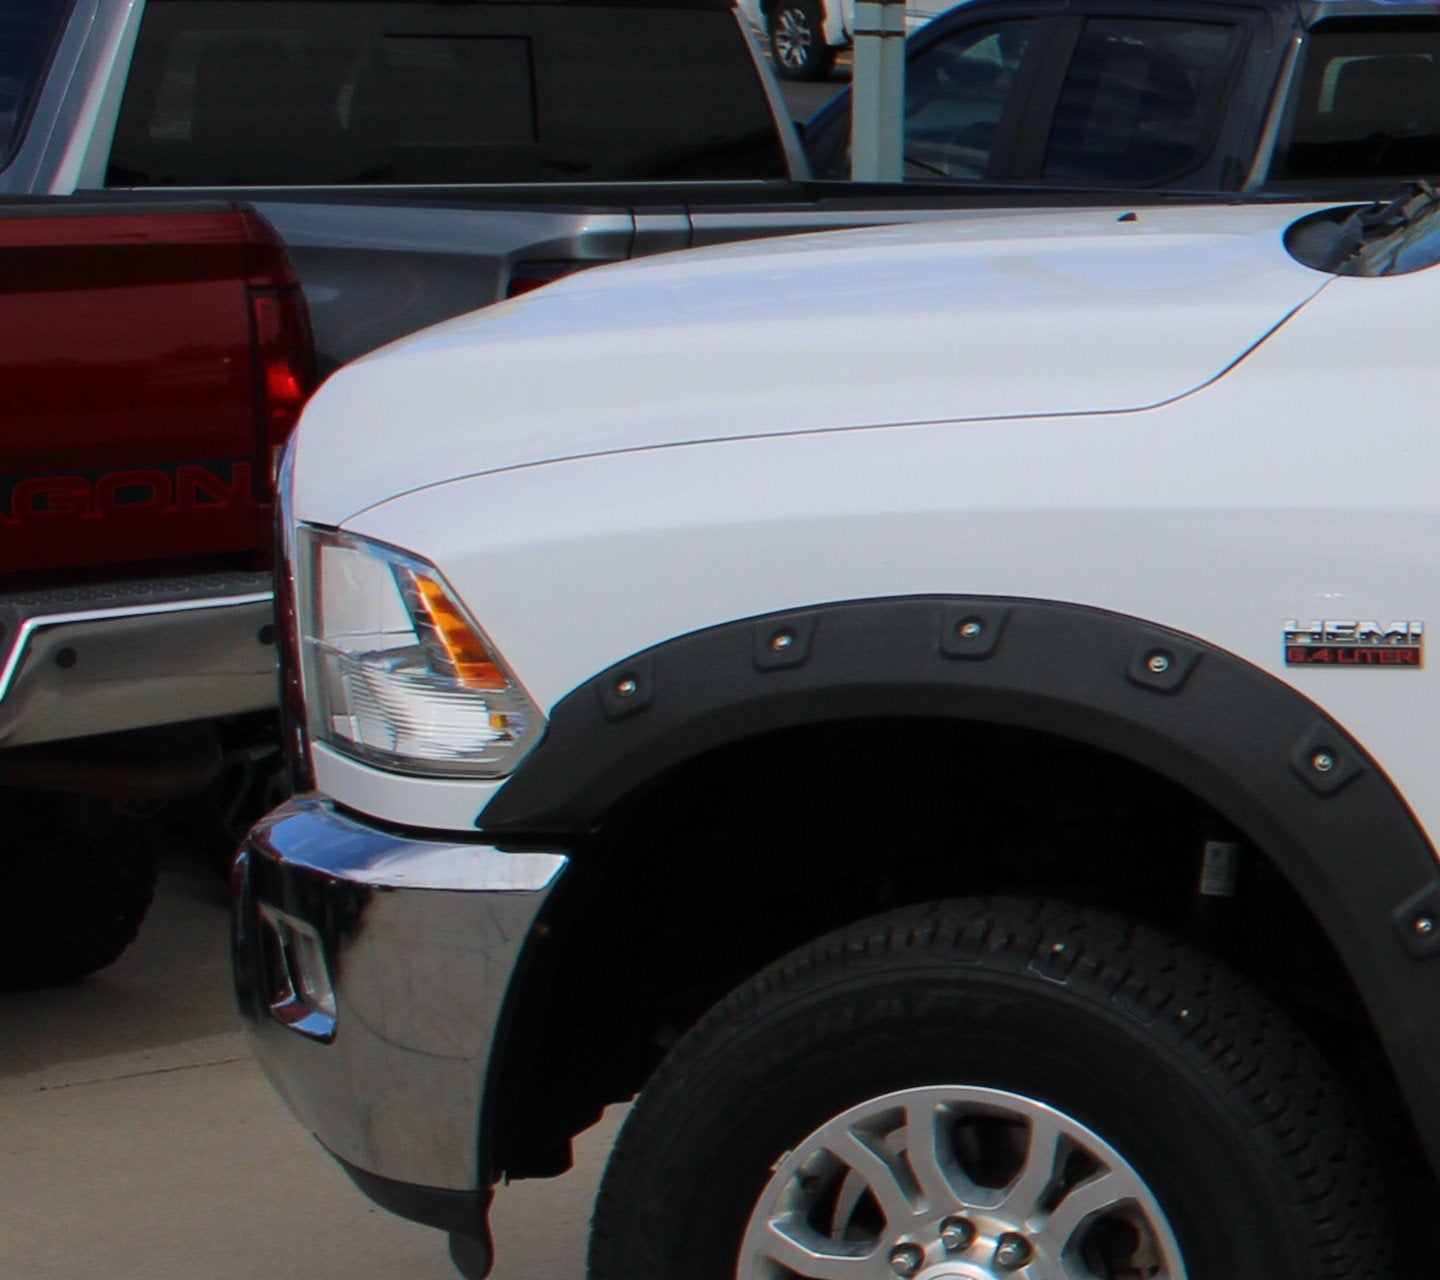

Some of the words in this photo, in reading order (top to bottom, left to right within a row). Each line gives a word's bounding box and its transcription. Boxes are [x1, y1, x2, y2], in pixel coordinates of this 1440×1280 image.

[0, 461, 254, 524] GON
[1284, 620, 1424, 646] HEMI
[1287, 647, 1332, 664] 6.4
[1336, 648, 1415, 665] LITER
